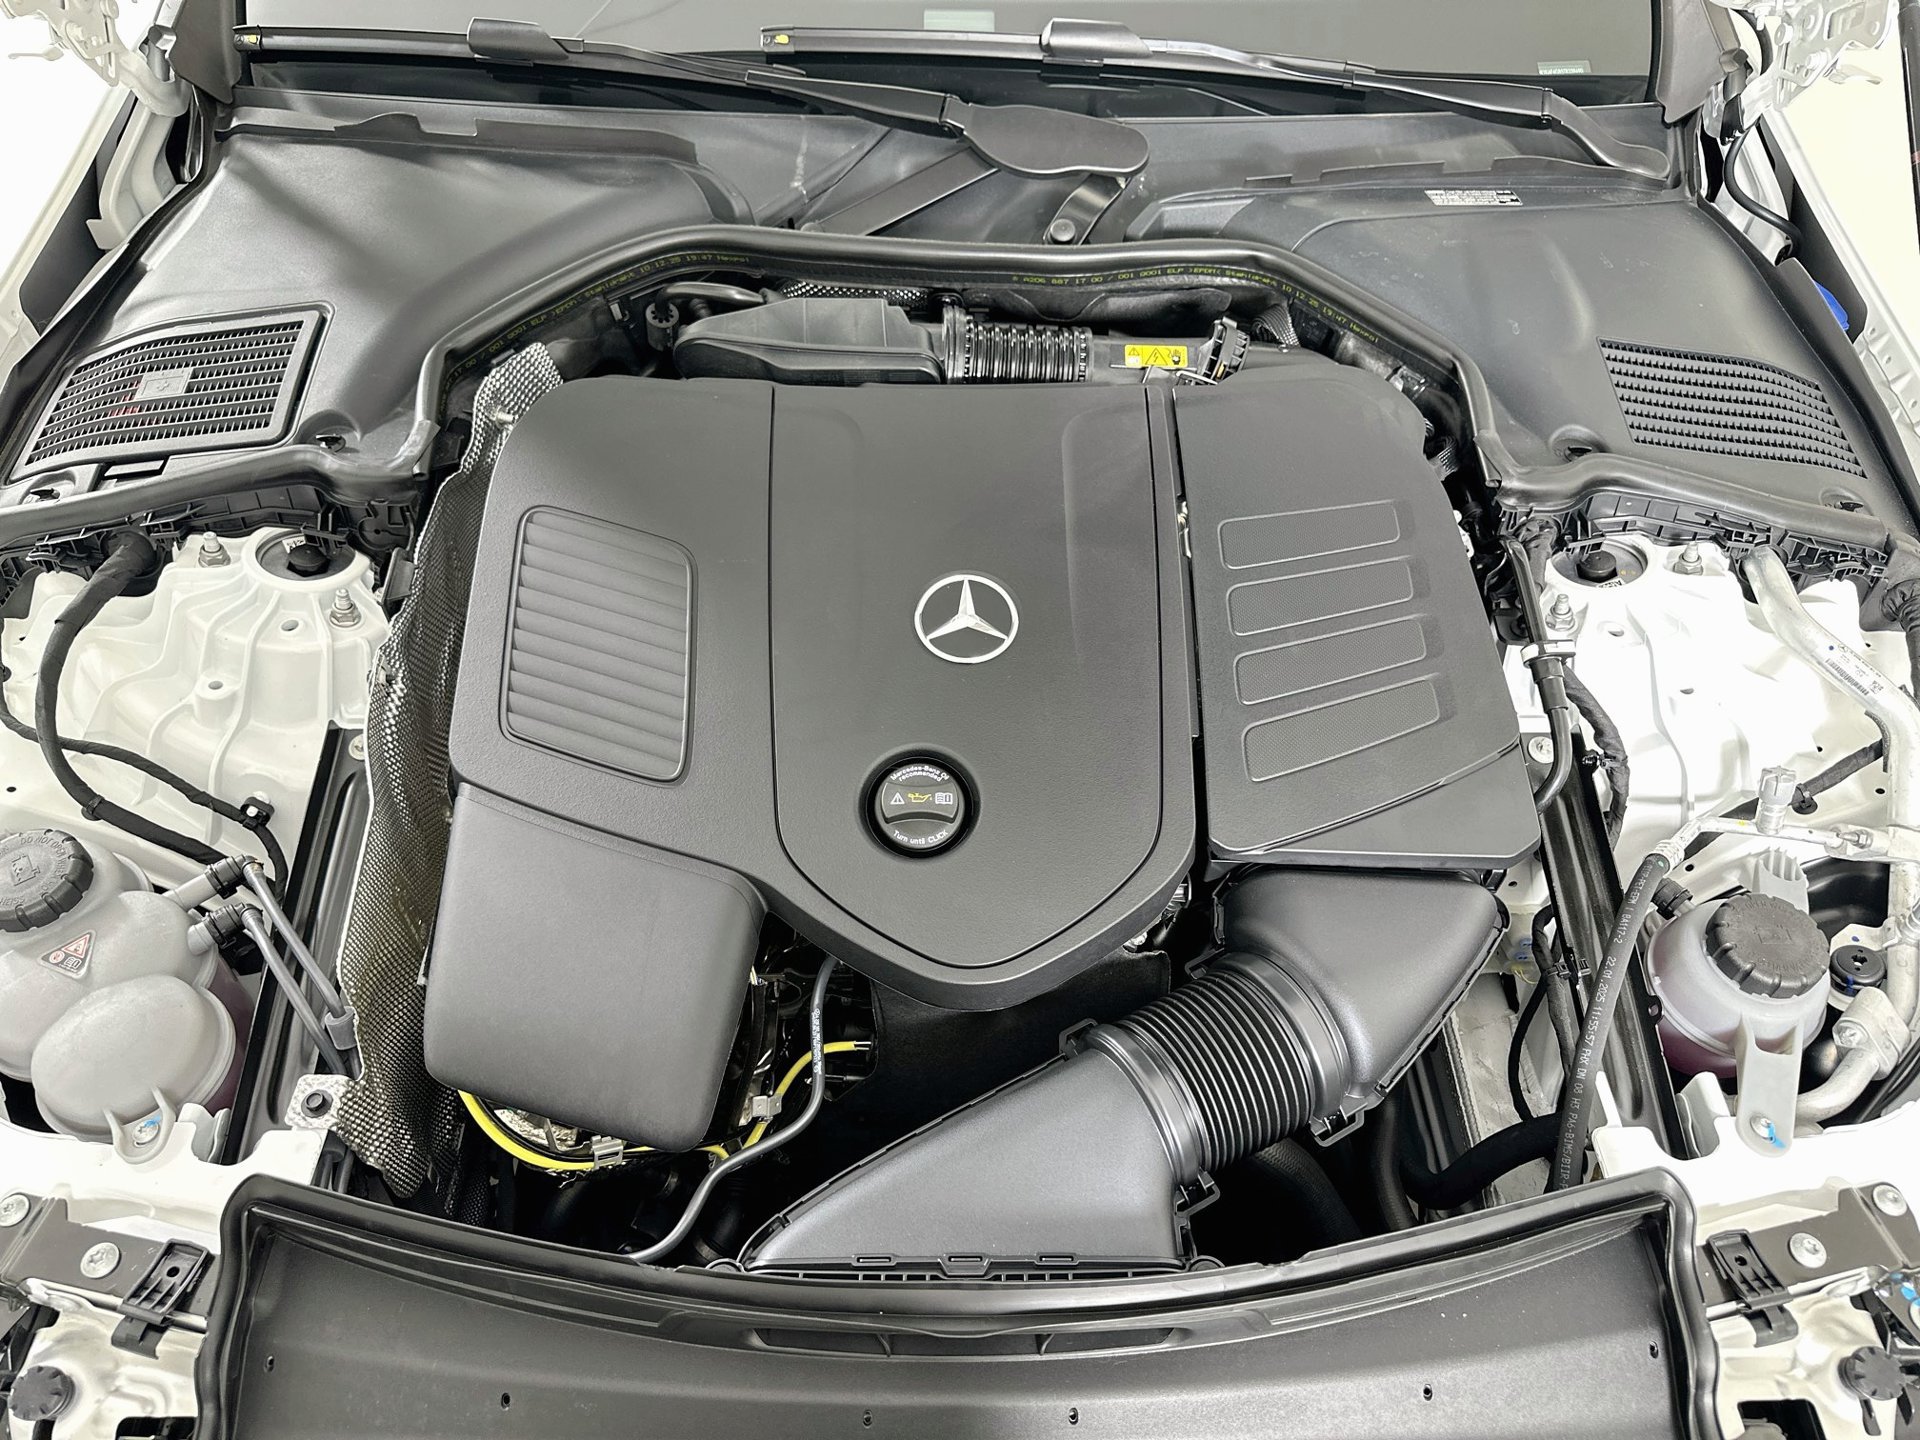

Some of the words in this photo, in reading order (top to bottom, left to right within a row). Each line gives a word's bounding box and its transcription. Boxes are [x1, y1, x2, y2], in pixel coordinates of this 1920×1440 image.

[890, 765, 940, 781] Mercedes-Benz
[898, 770, 941, 782] recommended
[893, 829, 908, 843] Turn
[909, 837, 926, 845] until
[927, 829, 949, 843] CLICK
[1595, 955, 1617, 1003] 22.01.2025
[1585, 1006, 1604, 1047] 11:55:57
[1578, 1048, 1592, 1066] PHX
[1575, 1067, 1587, 1080] DN
[1559, 1112, 1579, 1189] PA6-BIMS/BIIR-P
